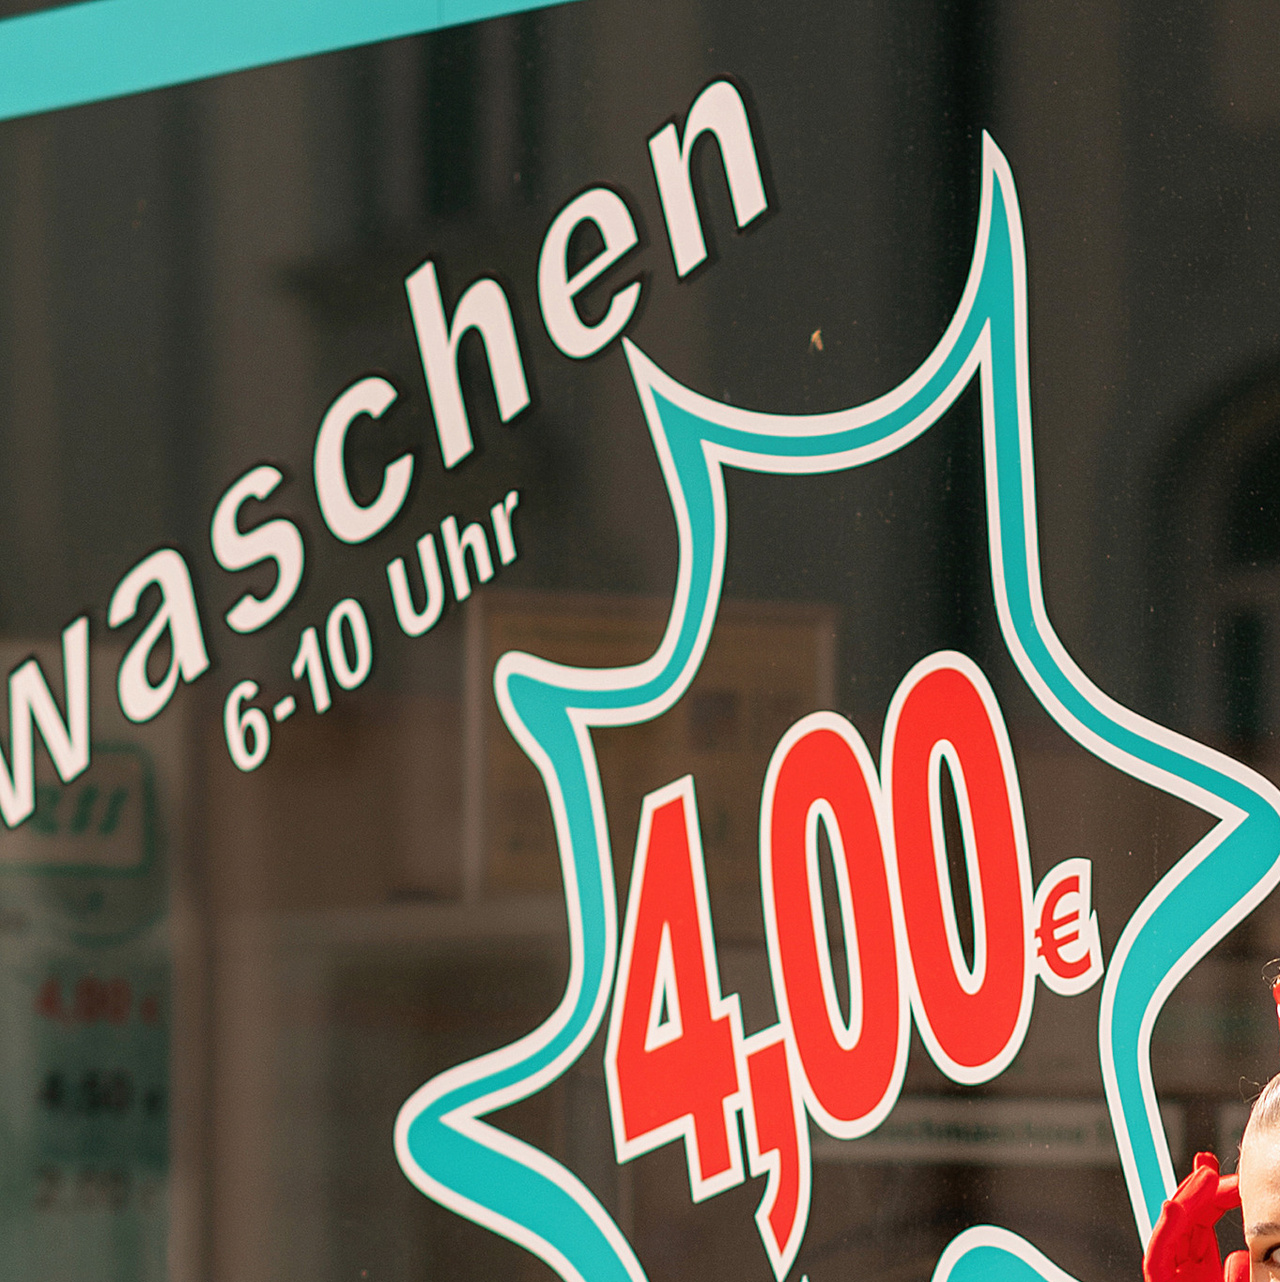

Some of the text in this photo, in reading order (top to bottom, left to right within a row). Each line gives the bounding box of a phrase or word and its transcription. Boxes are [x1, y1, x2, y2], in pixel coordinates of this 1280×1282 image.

[0, 79, 769, 827] waschen
[224, 491, 519, 771] 6-10 Uhr
